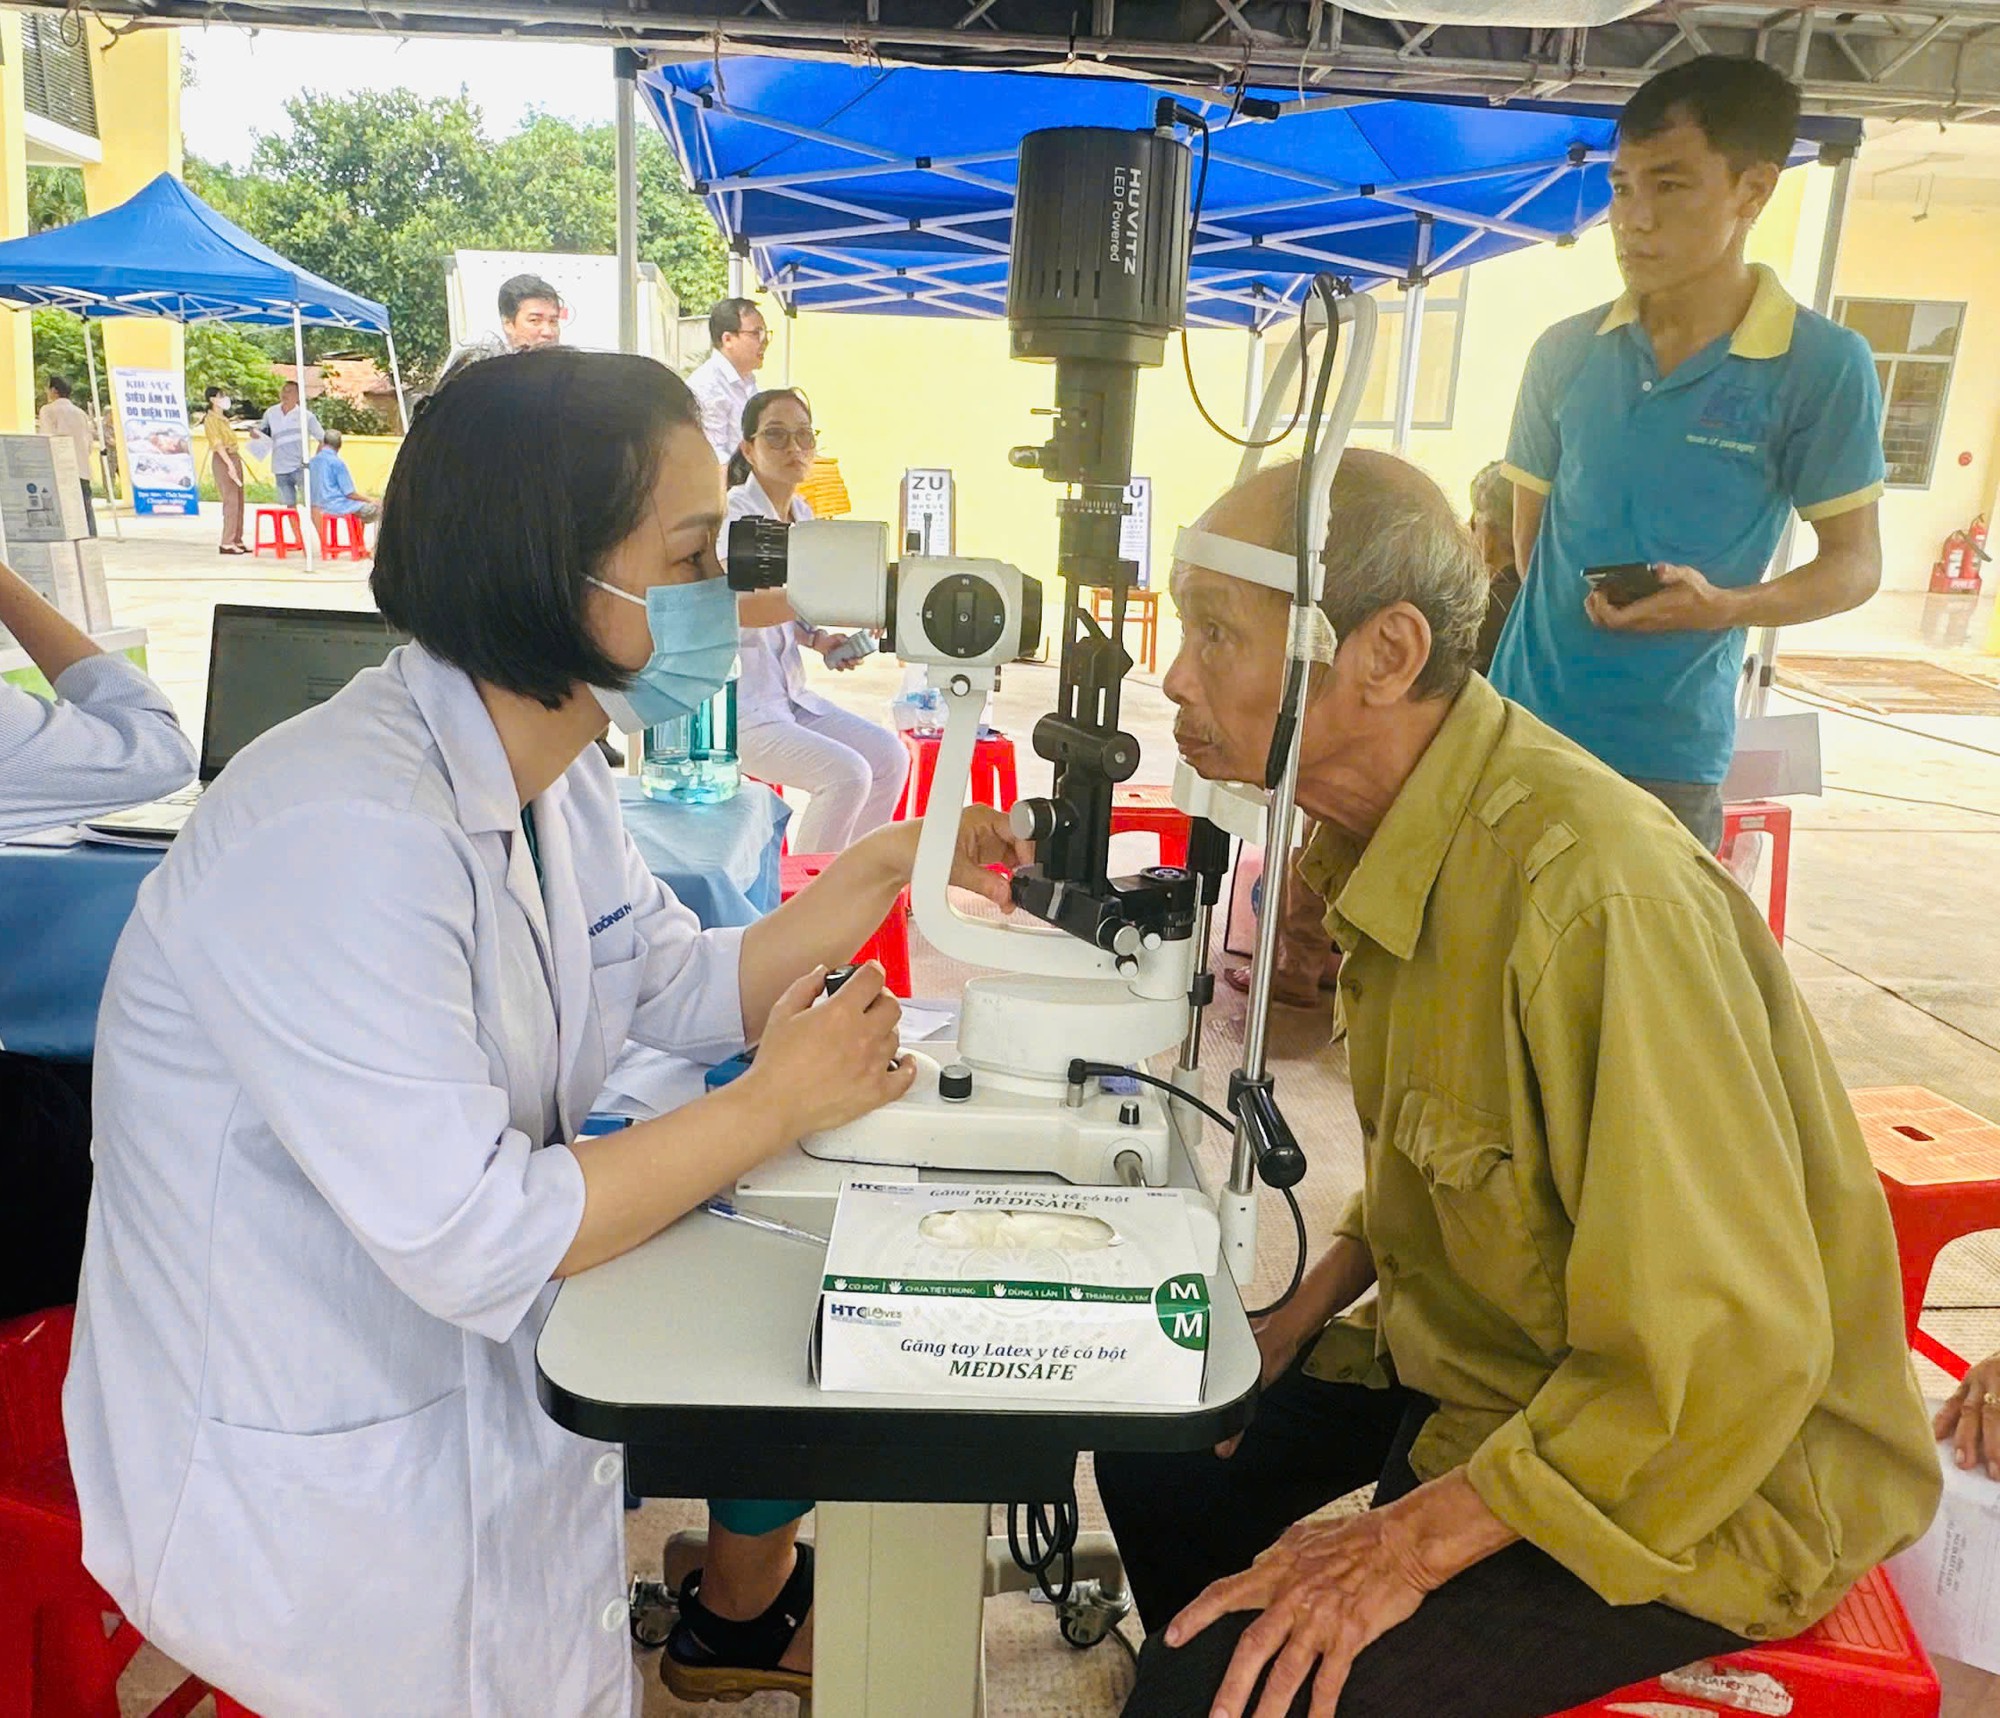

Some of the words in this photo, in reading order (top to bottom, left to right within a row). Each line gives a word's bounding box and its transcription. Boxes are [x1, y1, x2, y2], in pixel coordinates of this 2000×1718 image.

[1113, 166, 1126, 198] LED
[1110, 201, 1124, 262] Powered
[1124, 168, 1142, 275] HUVITZ
[125, 391, 146, 403] SIÊU
[164, 392, 177, 405] VÀ
[164, 408, 181, 419] TIM
[974, 1196, 1088, 1211] MEDISAFE
[1004, 1189, 1047, 1198] Latex
[1170, 1281, 1201, 1300] M
[1173, 1312, 1204, 1339] M
[900, 1338, 947, 1358] Găng
[951, 1342, 981, 1359] tay
[983, 1342, 1034, 1358] Latex
[1033, 1347, 1049, 1361] y
[1052, 1343, 1073, 1359] tế
[1073, 1345, 1094, 1360] có
[1097, 1345, 1129, 1363] bột
[948, 1359, 1078, 1382] MEDISAFE
